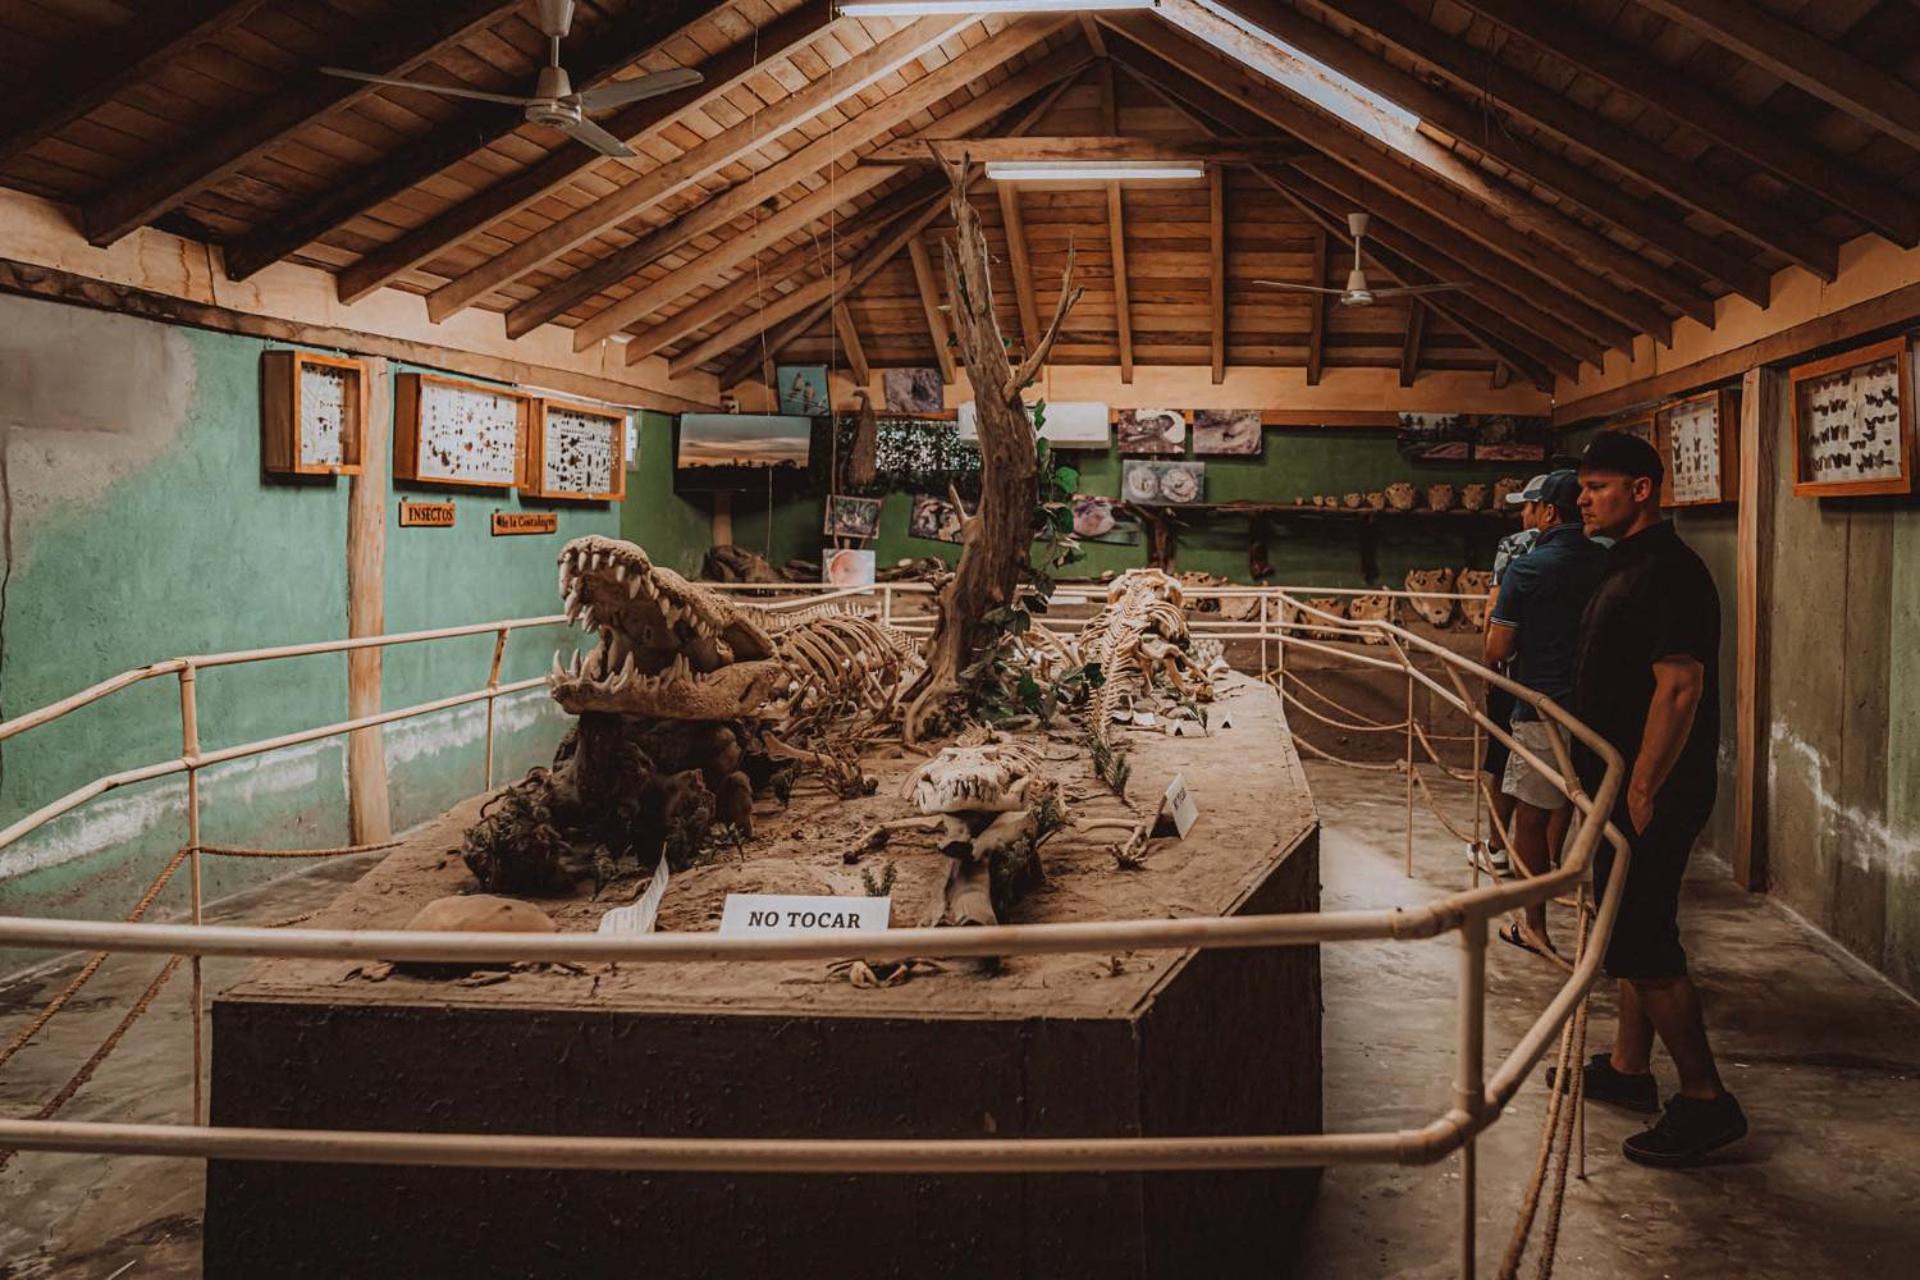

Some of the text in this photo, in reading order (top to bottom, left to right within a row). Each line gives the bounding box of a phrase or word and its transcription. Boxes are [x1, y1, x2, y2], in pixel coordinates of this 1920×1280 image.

[409, 507, 453, 521] INSECTOS
[748, 911, 861, 928] NO TOCAR
